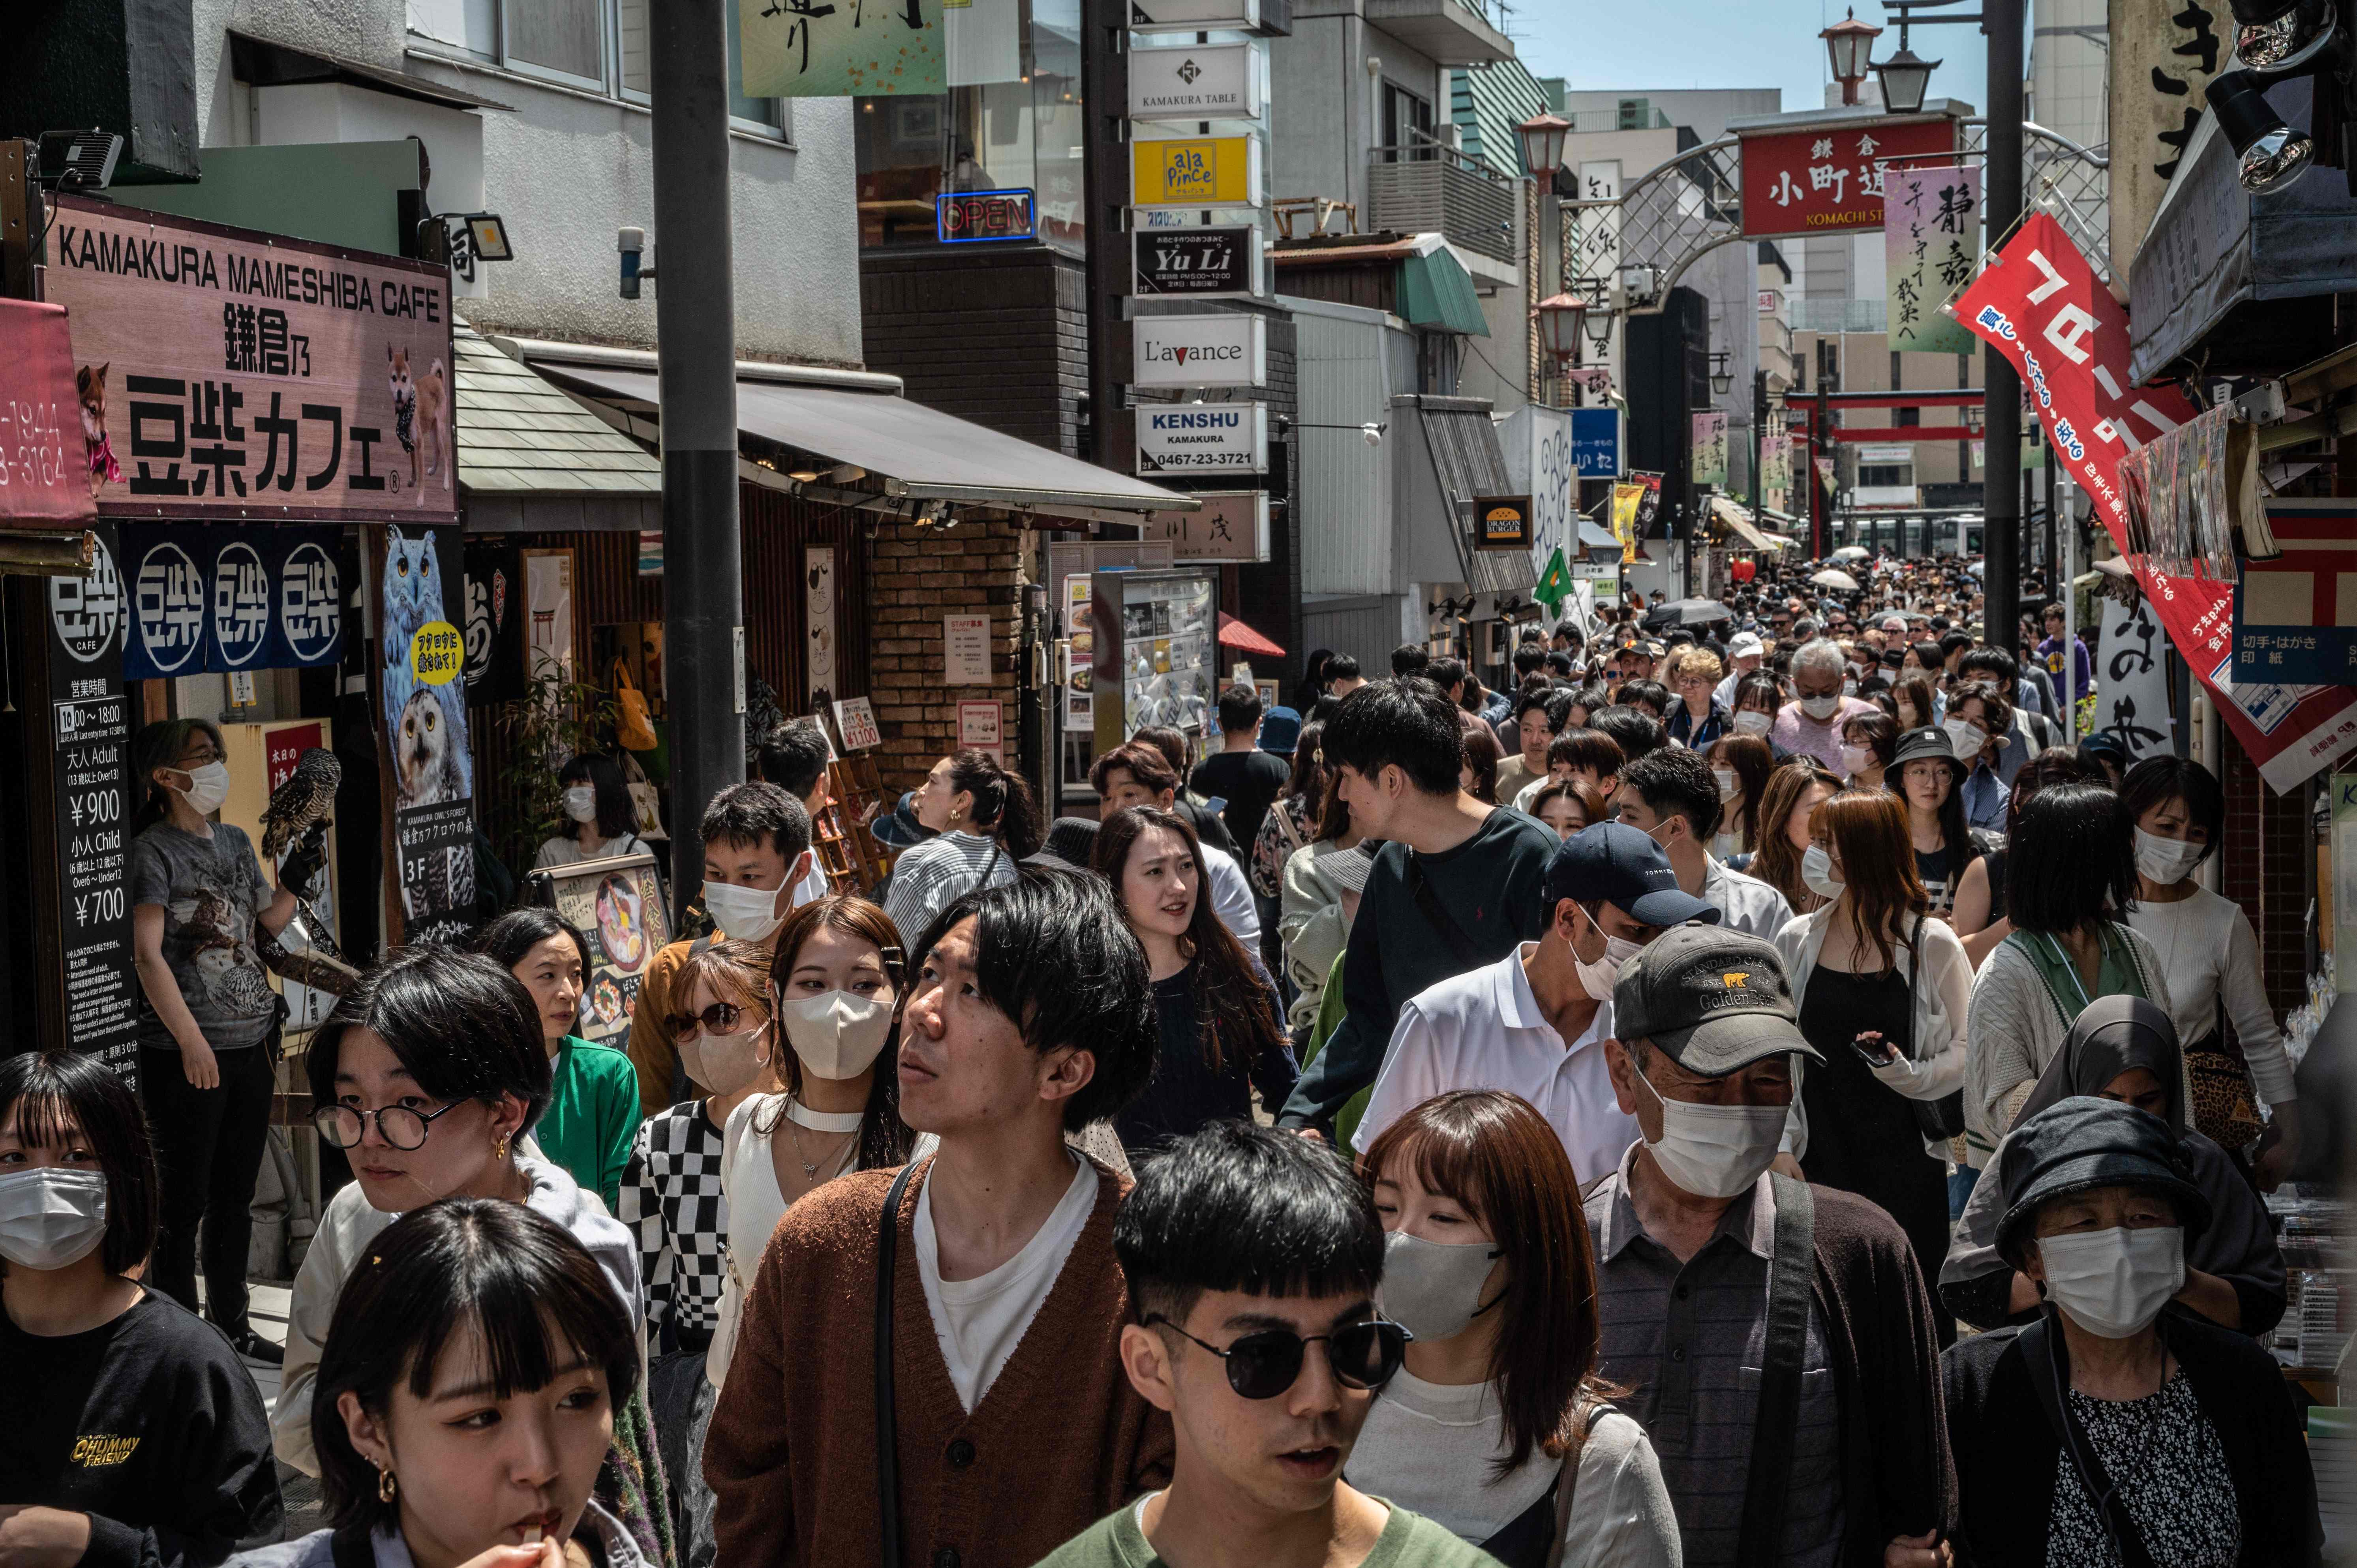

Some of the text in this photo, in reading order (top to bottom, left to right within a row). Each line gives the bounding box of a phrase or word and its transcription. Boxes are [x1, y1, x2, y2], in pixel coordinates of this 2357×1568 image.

[1143, 94, 1237, 107] KAMAKURA TABLE
[1811, 134, 1880, 159] 鎌倉
[1174, 149, 1204, 171] ala
[1770, 161, 1886, 206] 小町通
[943, 199, 1027, 231] OPEN
[1807, 209, 1886, 226] KOMACHI ST
[1156, 249, 1231, 270] Yu Li
[59, 225, 439, 323] KAMAKURA MAMESHIBA CAFE
[224, 302, 311, 377] 鎌倉乃
[1145, 341, 1242, 367] L'avance
[1152, 413, 1239, 429] KENSHU
[126, 375, 385, 498] 豆柴カフェ
[1167, 435, 1224, 444] KAMAKURA
[1157, 453, 1251, 465] 0467-23-3721
[77, 641, 96, 651] CAFE
[418, 632, 458, 652] フクロウに
[2242, 635, 2316, 649] 切手・はがき
[418, 652, 456, 673] 癒されて！
[2241, 651, 2283, 664] 印紙
[71, 679, 106, 698] 営業時間
[98, 705, 120, 723] 18:00
[79, 731, 88, 740] Last
[88, 730, 98, 740] entry
[99, 728, 108, 737] time
[109, 725, 127, 736] 17:30PM)
[67, 744, 118, 769] 大人 Adult
[272, 748, 296, 764] 本日の
[98, 768, 119, 782] Over13)
[70, 789, 120, 826] ¥900
[407, 807, 467, 825] KAMAKURA OWL'S FOREST
[402, 816, 473, 846] 鎌倉乃フクロウの森
[71, 829, 120, 857] 小人 Child
[73, 875, 90, 888] Over6
[99, 869, 122, 884] Under12
[407, 857, 425, 882] 3F
[75, 887, 124, 927] ¥700
[71, 970, 87, 979] Attendant
[1681, 956, 1741, 983] STANDARD
[90, 987, 98, 997] letter
[102, 983, 114, 993] consent
[77, 1001, 85, 1010] adult
[86, 996, 108, 1007] accompanying
[1700, 990, 1775, 1011] Golden Bear
[73, 1023, 86, 1032] Children
[87, 1018, 98, 1028] under5
[111, 1024, 122, 1034] parents
[123, 1059, 136, 1071] min.
[70, 1437, 141, 1462] CHUMMY
[83, 1451, 130, 1467] FRIEND
